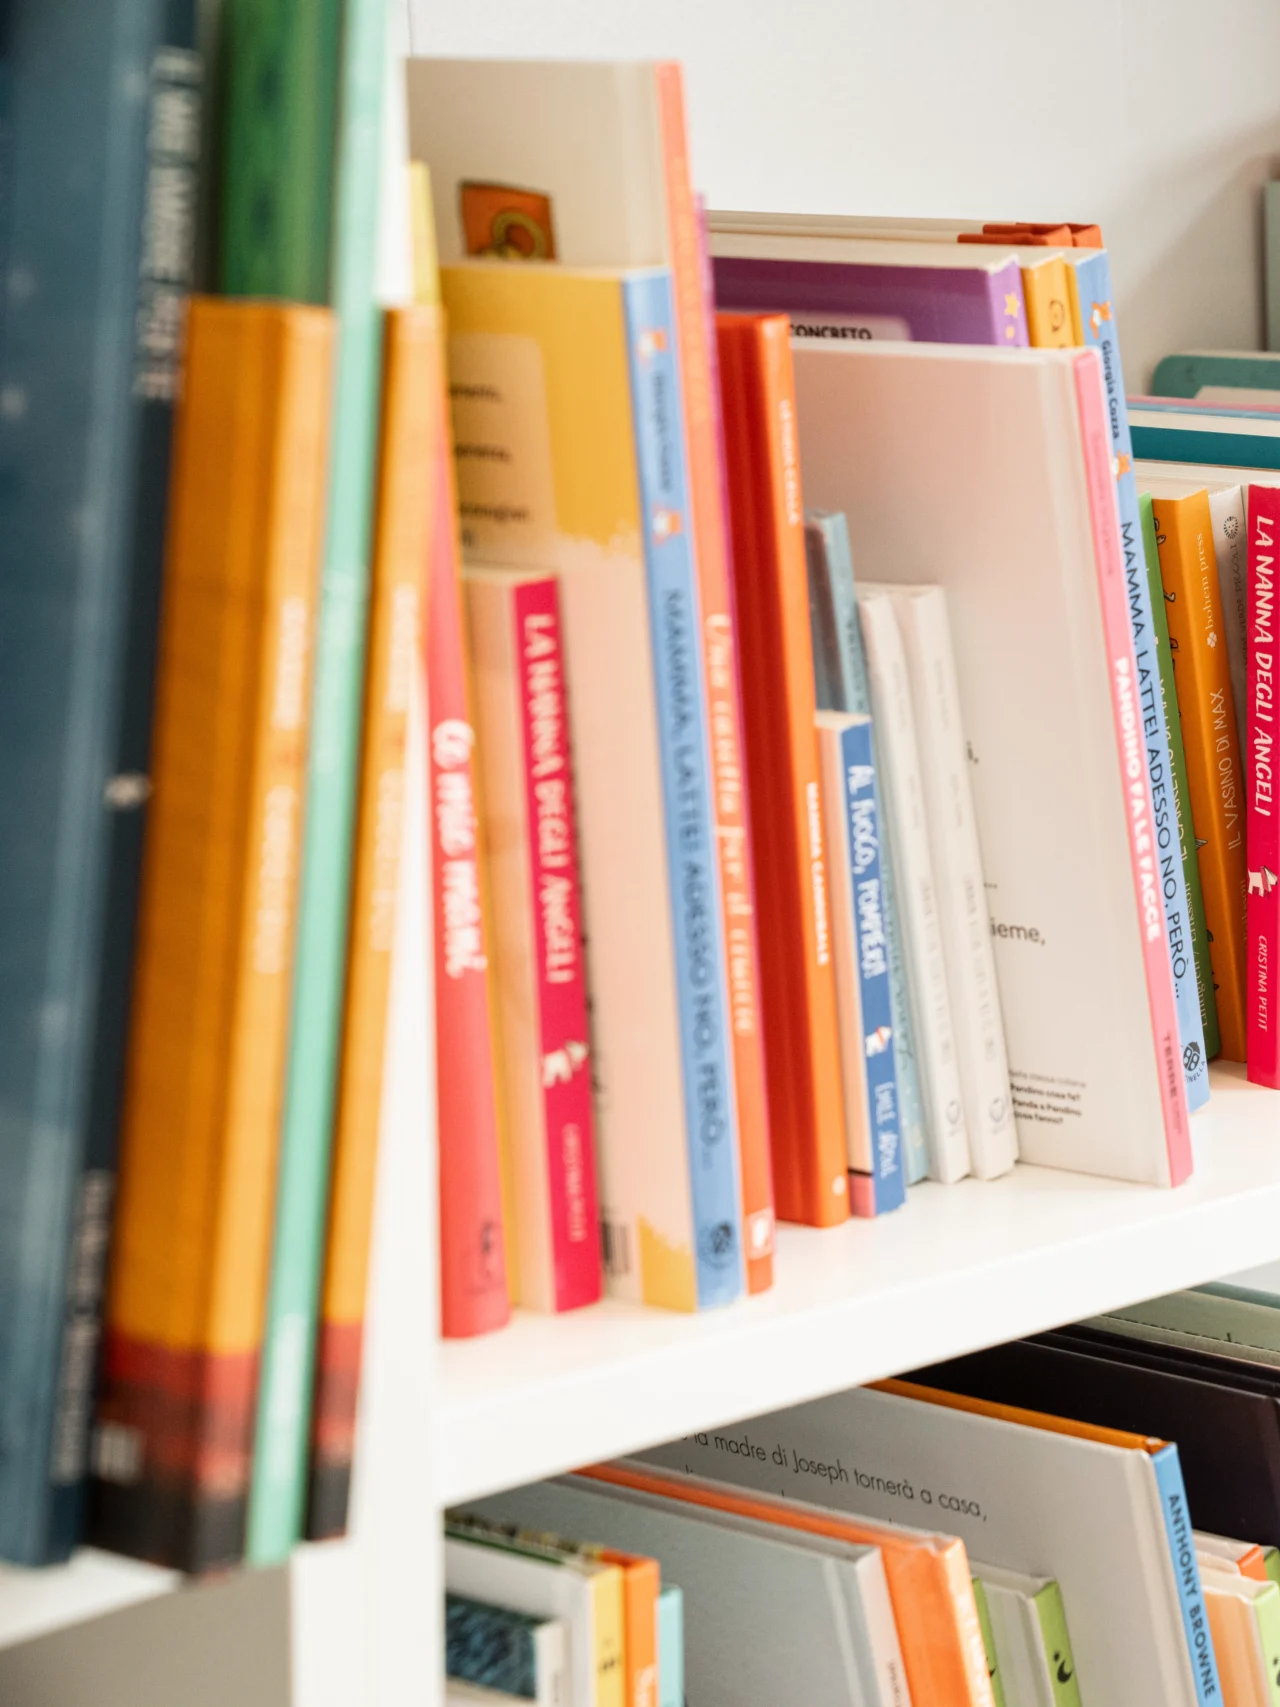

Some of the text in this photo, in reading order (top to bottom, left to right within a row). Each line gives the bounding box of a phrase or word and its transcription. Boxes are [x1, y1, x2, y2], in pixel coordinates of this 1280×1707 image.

[790, 324, 872, 340] ONCRETO
[1101, 340, 1120, 440] Giorgia Cozza
[1121, 521, 1146, 646] MAMMA,
[1196, 532, 1215, 631] bohem press
[1136, 650, 1159, 739] LATTE!
[1253, 514, 1275, 817] LA NANNA DEGLI ANGELI
[847, 764, 876, 796] AL
[1114, 656, 1163, 943] PANDINO FA LE FACCE
[1147, 747, 1171, 849] ADESSO
[1210, 687, 1243, 851] IL VASINO DI MAX
[1160, 856, 1177, 908] NO,
[1257, 934, 1269, 1033] CRISTINA PETIT
[714, 1435, 767, 1461] madre
[772, 1443, 788, 1467] di
[793, 1449, 850, 1484] Joseph
[853, 1467, 915, 1500] tornerà
[920, 1488, 934, 1504] a
[938, 1491, 989, 1522] casa,
[1168, 1493, 1217, 1700] ANTHONY BROWNE
